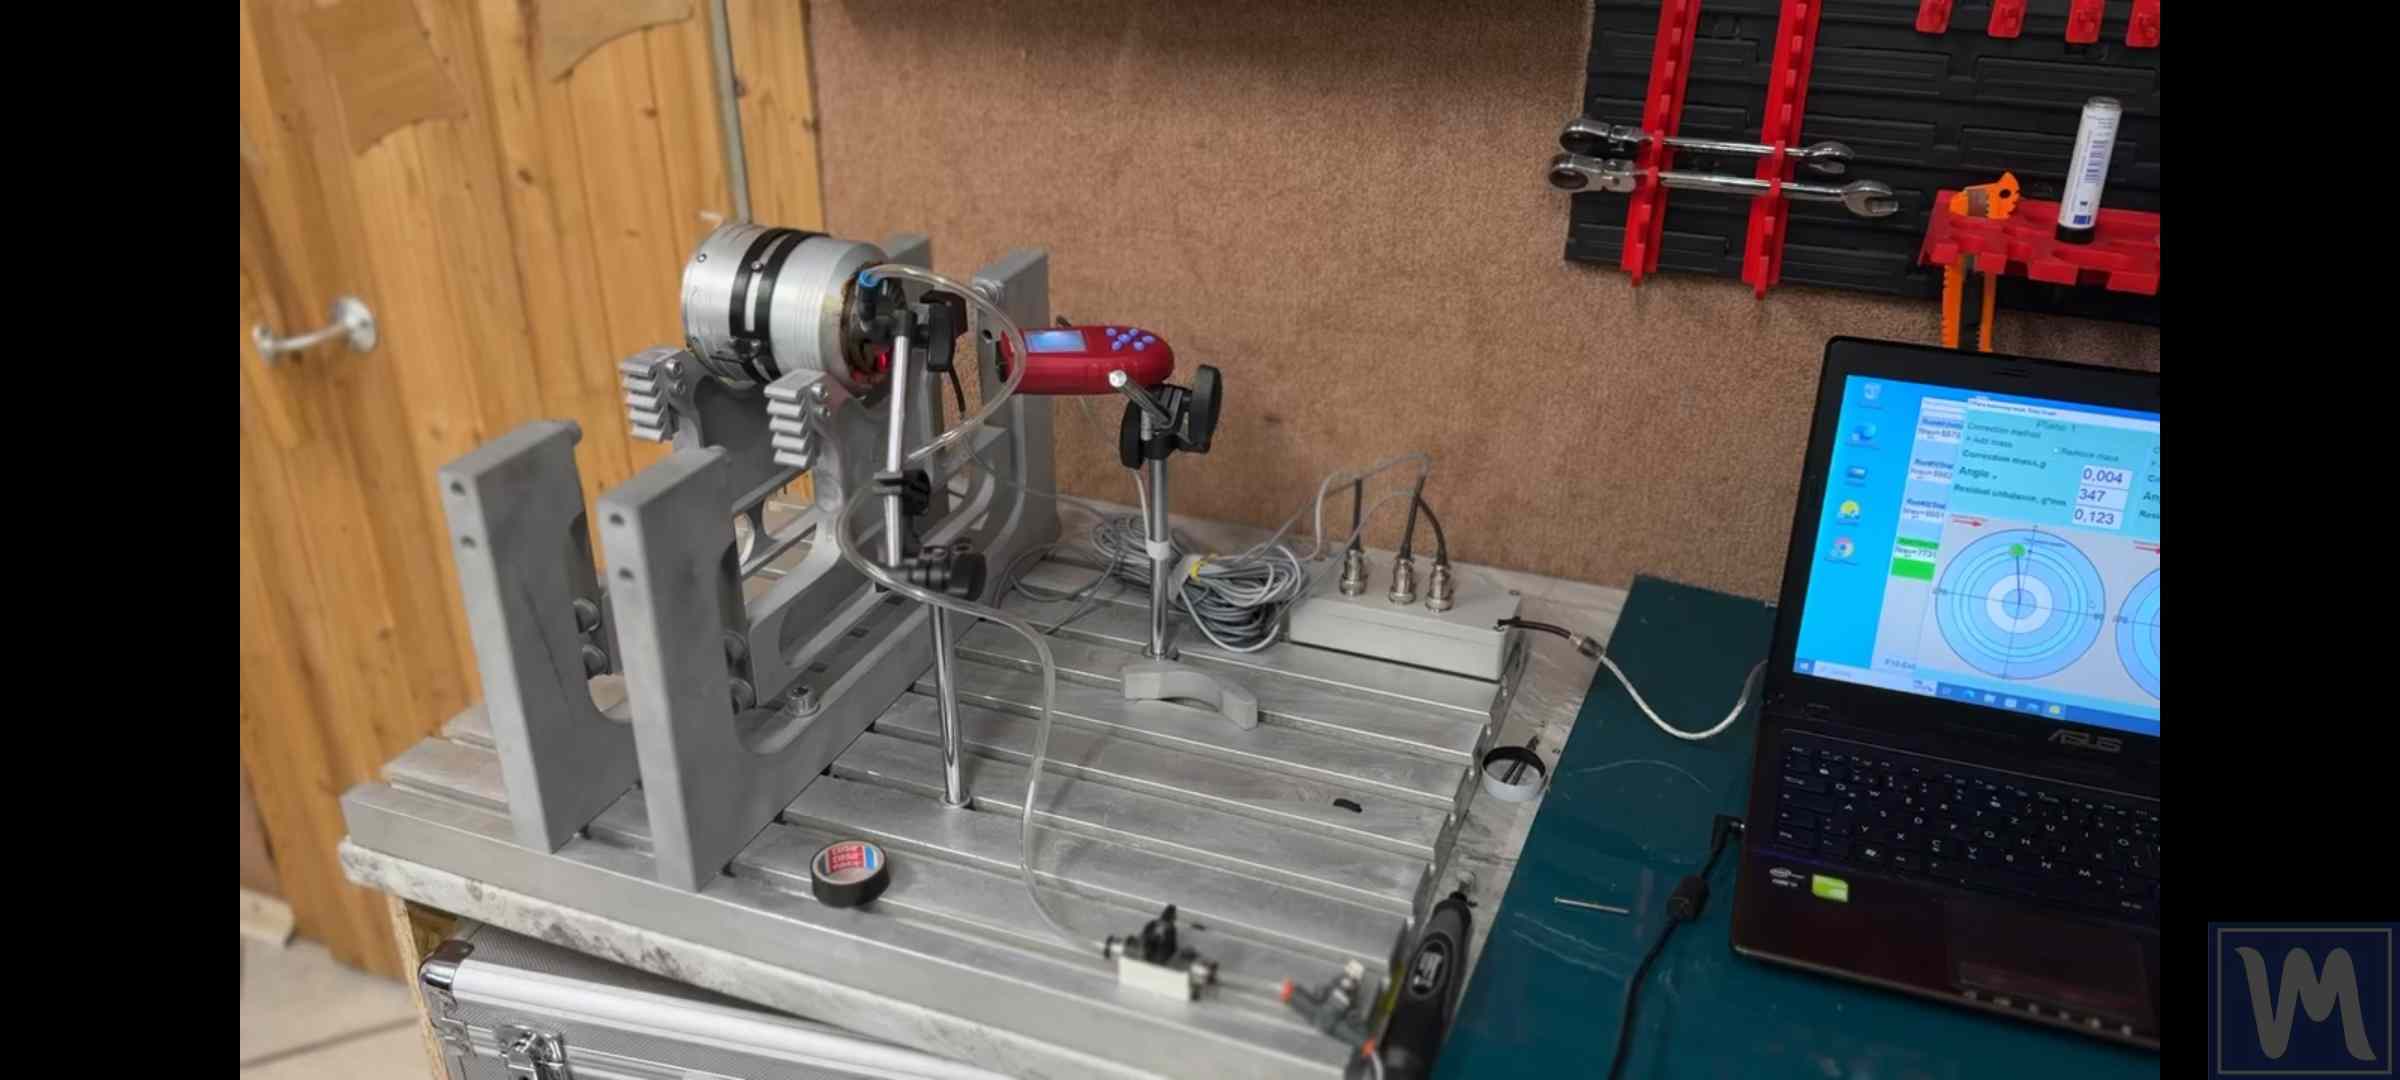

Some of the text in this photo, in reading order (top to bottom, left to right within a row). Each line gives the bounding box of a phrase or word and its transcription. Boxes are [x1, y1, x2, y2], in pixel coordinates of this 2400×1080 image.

[2083, 467, 2123, 484] 0.004
[2079, 488, 2106, 502] 347
[2074, 508, 2115, 525] 0.123
[2048, 729, 2124, 752] ASUS
